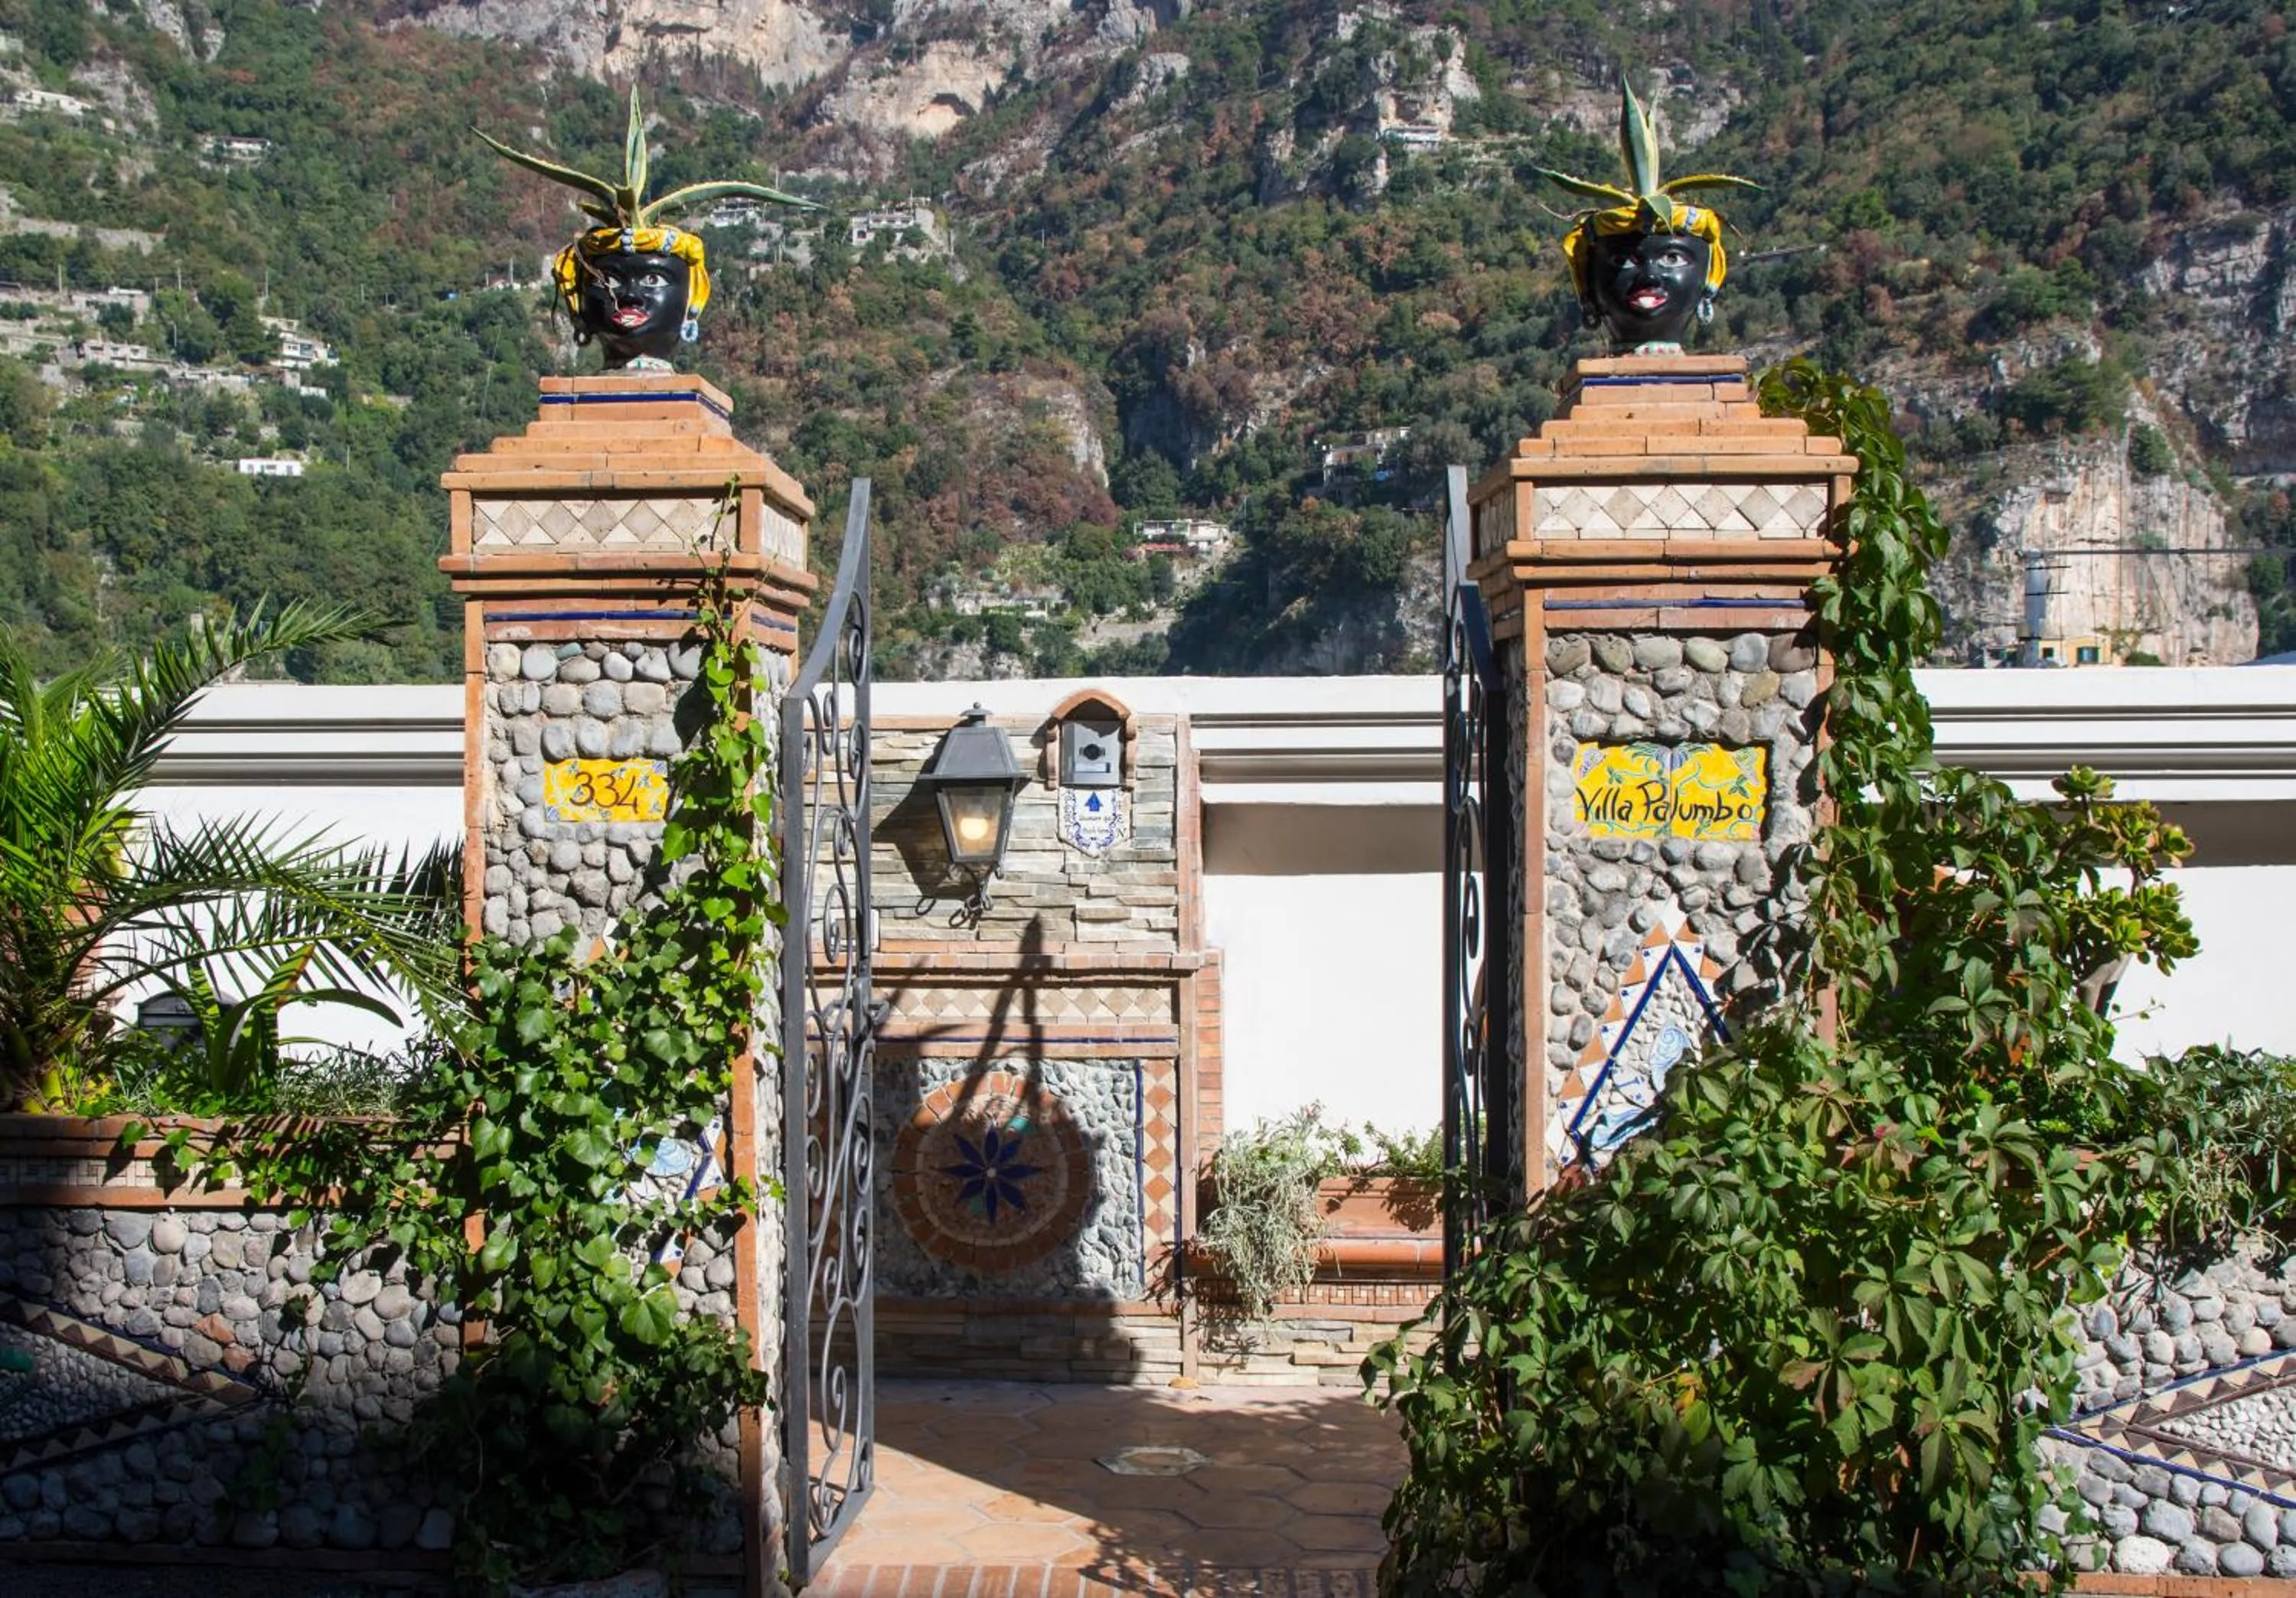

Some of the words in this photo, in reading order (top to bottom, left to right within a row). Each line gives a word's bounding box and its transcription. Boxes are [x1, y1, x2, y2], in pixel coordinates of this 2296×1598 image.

[569, 771, 638, 814] 334
[1575, 785, 1633, 822] Villa
[1636, 780, 1753, 823] Palumbo
